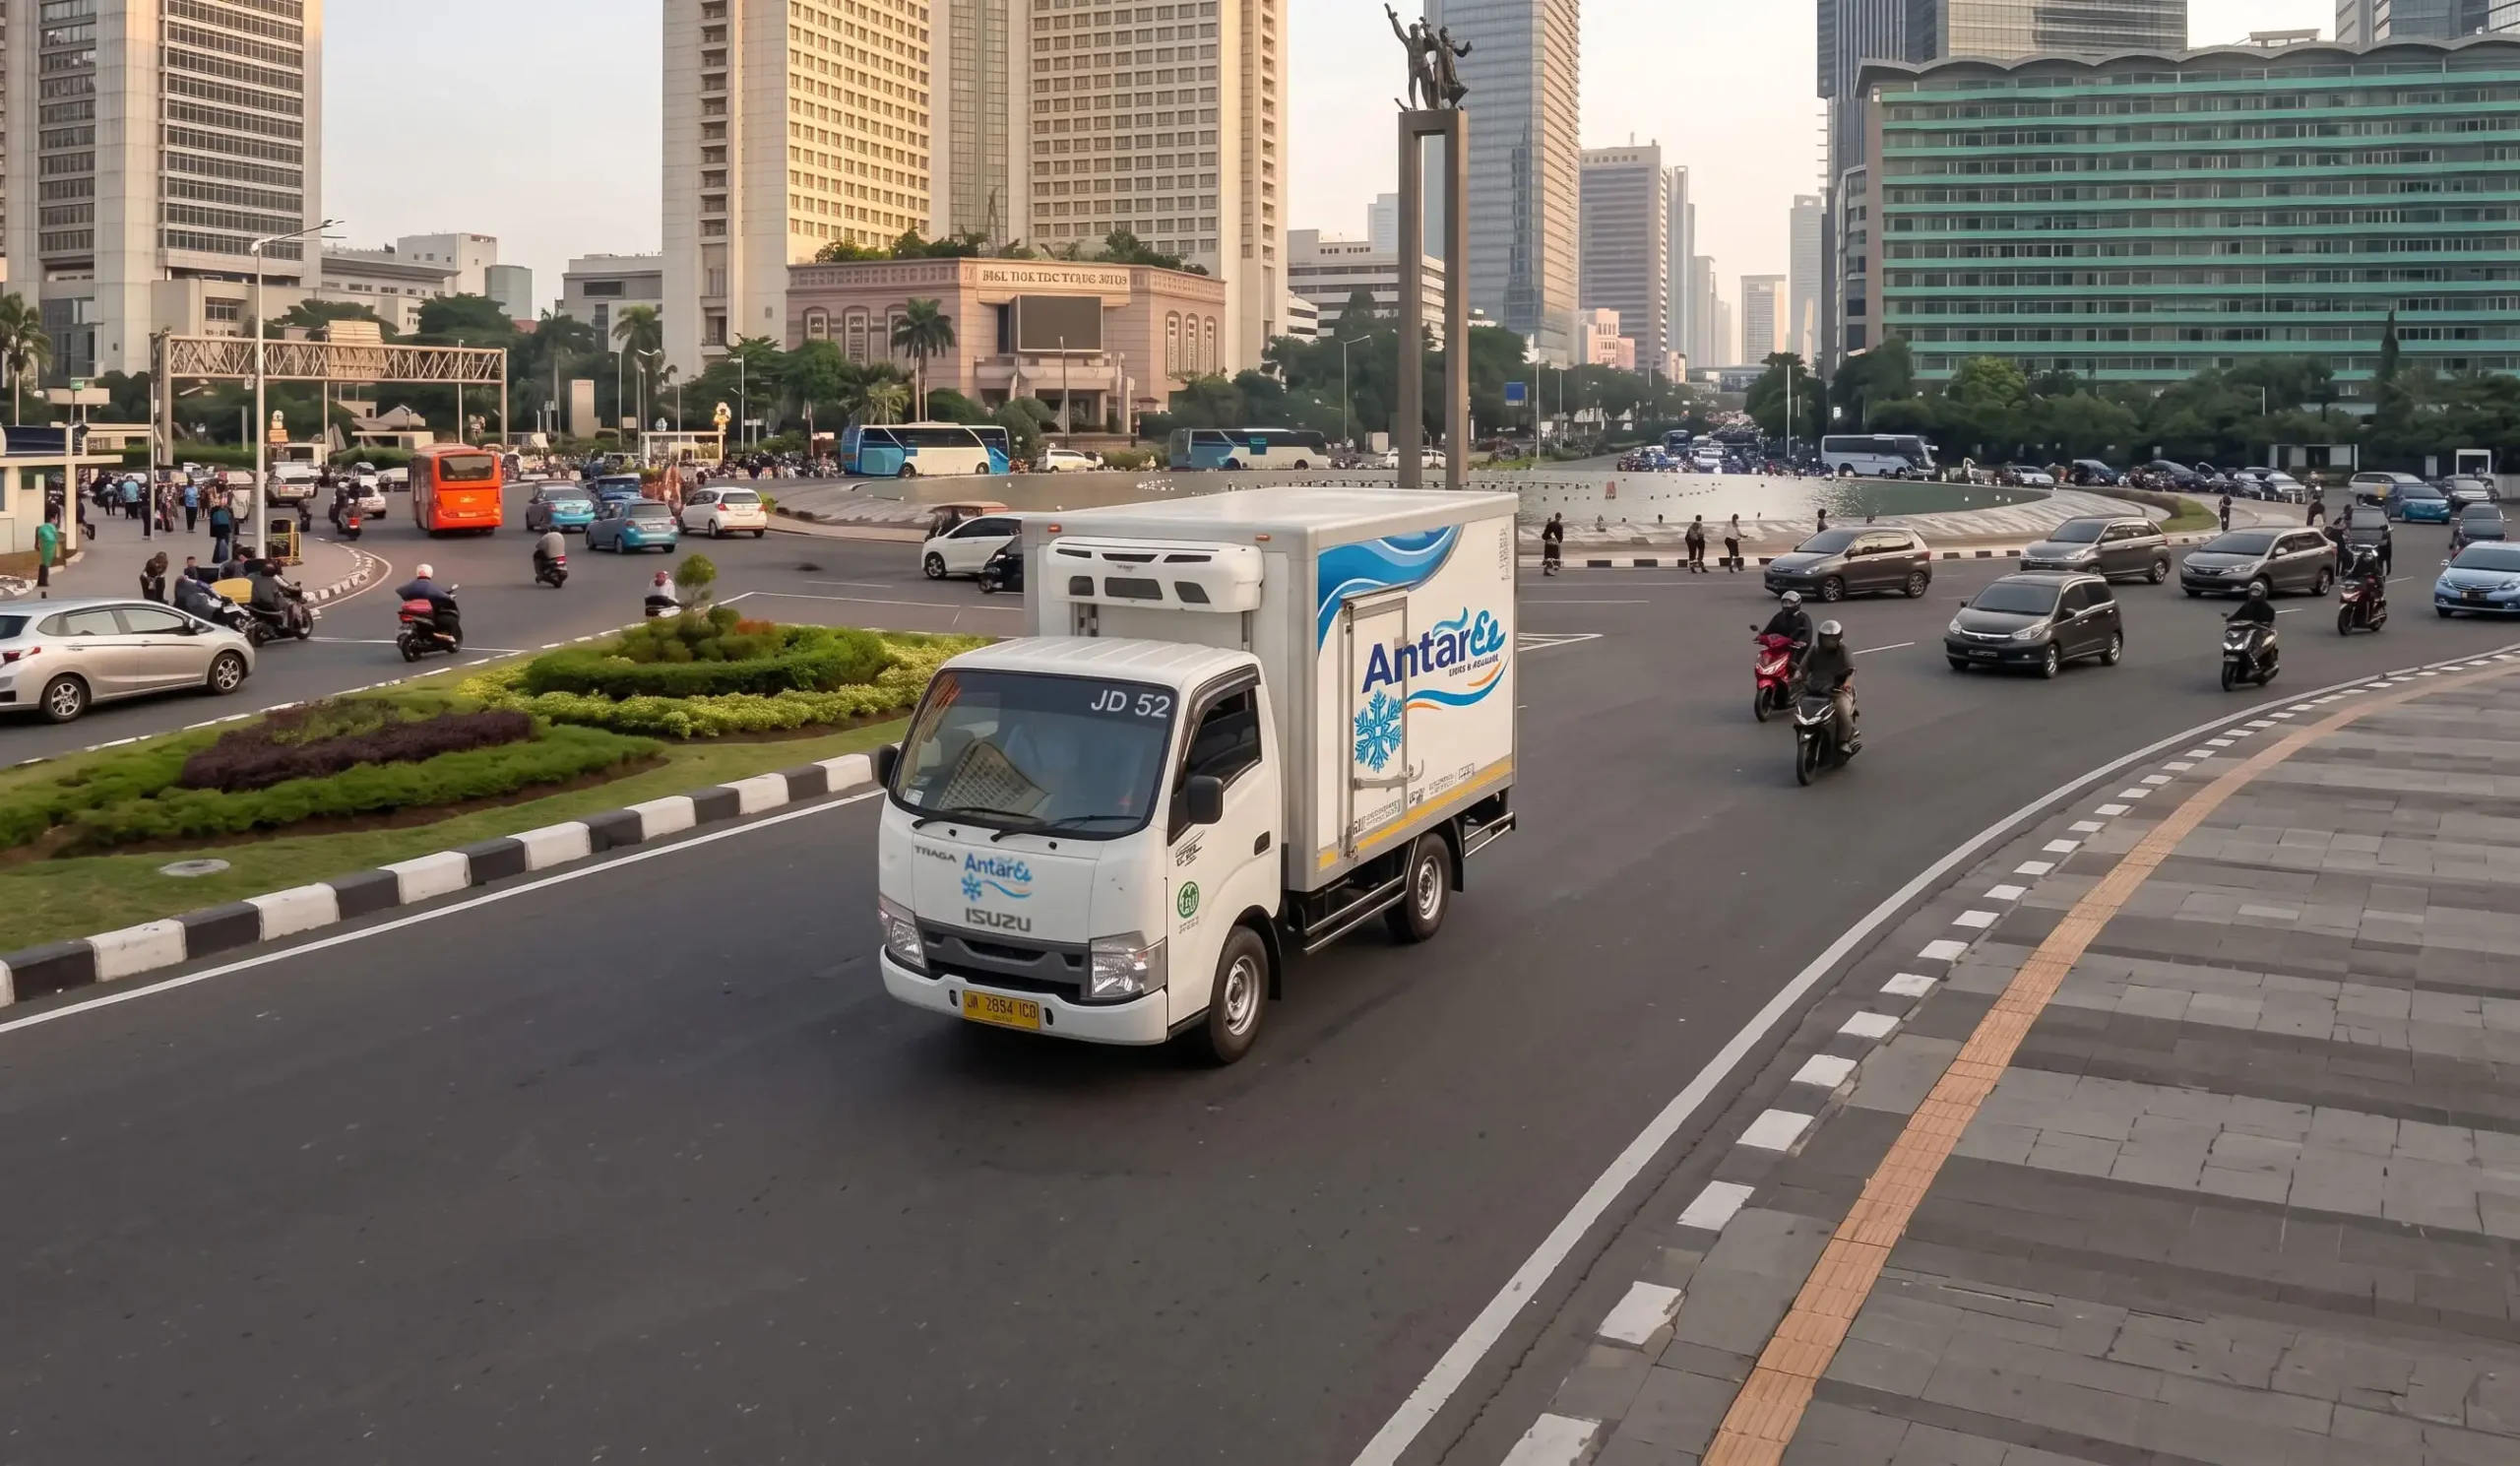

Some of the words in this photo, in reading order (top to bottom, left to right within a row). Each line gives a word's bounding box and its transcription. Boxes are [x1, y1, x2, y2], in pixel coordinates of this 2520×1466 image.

[1091, 689, 1127, 712] JD
[1134, 693, 1170, 719] 52
[965, 907, 1032, 932] ISUZU
